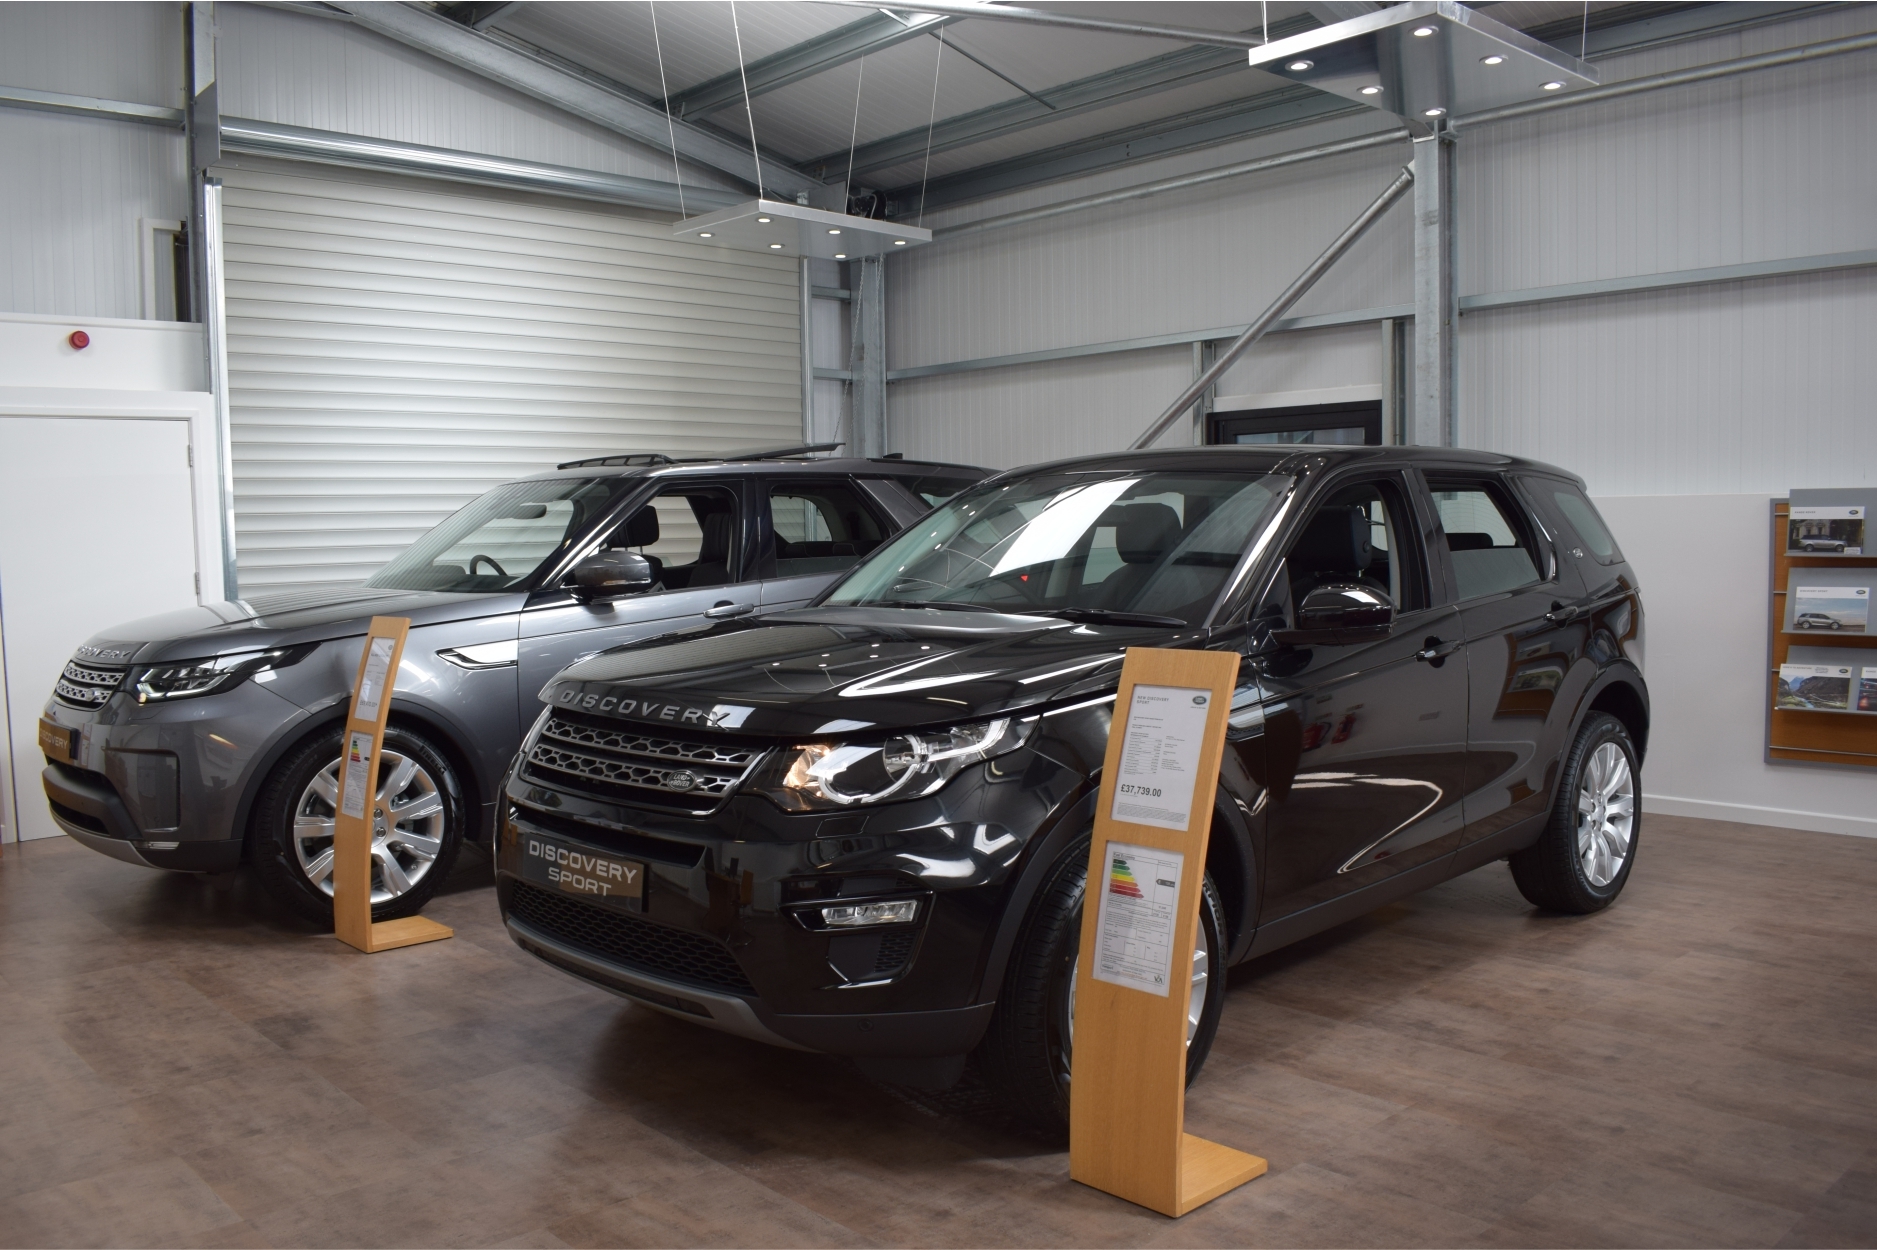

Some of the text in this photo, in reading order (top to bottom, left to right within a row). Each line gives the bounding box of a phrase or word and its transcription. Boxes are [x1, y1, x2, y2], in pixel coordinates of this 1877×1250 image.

[78, 645, 131, 659] SCOVERY
[559, 689, 731, 727] DISCOVERY
[672, 780, 690, 788] ROVER
[673, 773, 688, 781] LAND
[1120, 783, 1162, 798] £37,739.00
[529, 840, 638, 884] DISCOVERY
[548, 866, 612, 897] SPORT
[1202, 878, 1224, 936] RPION
